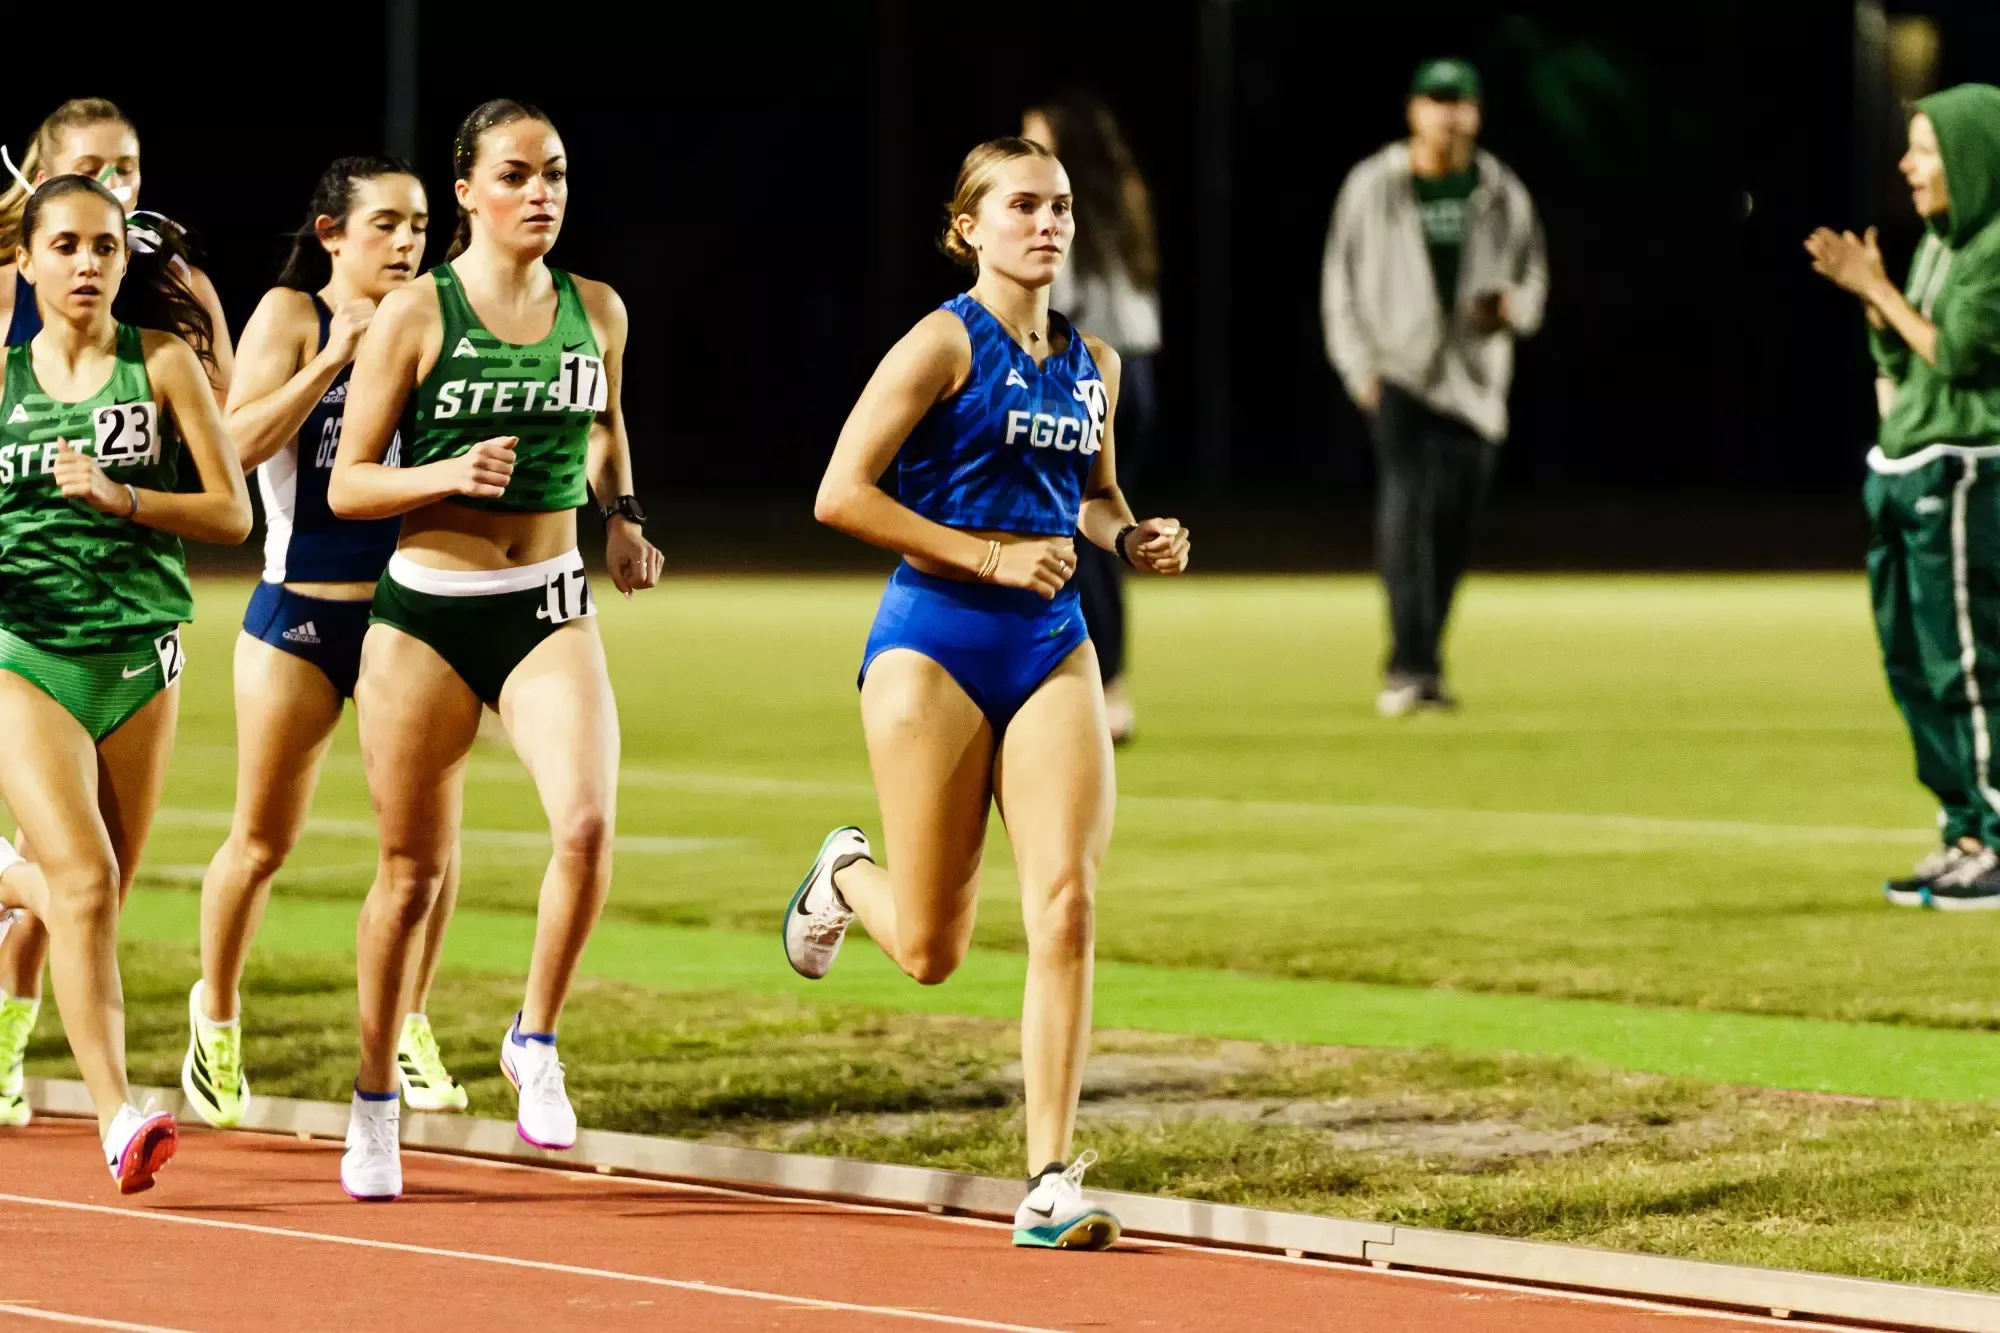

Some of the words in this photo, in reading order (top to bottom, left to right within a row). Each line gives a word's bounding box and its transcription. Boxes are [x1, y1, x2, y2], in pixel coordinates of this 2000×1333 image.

[434, 378, 598, 420] STETS
[565, 357, 599, 407] 17
[98, 405, 151, 456] 23
[0, 435, 162, 485] STET
[550, 567, 588, 619] 17
[160, 634, 183, 684] 2
